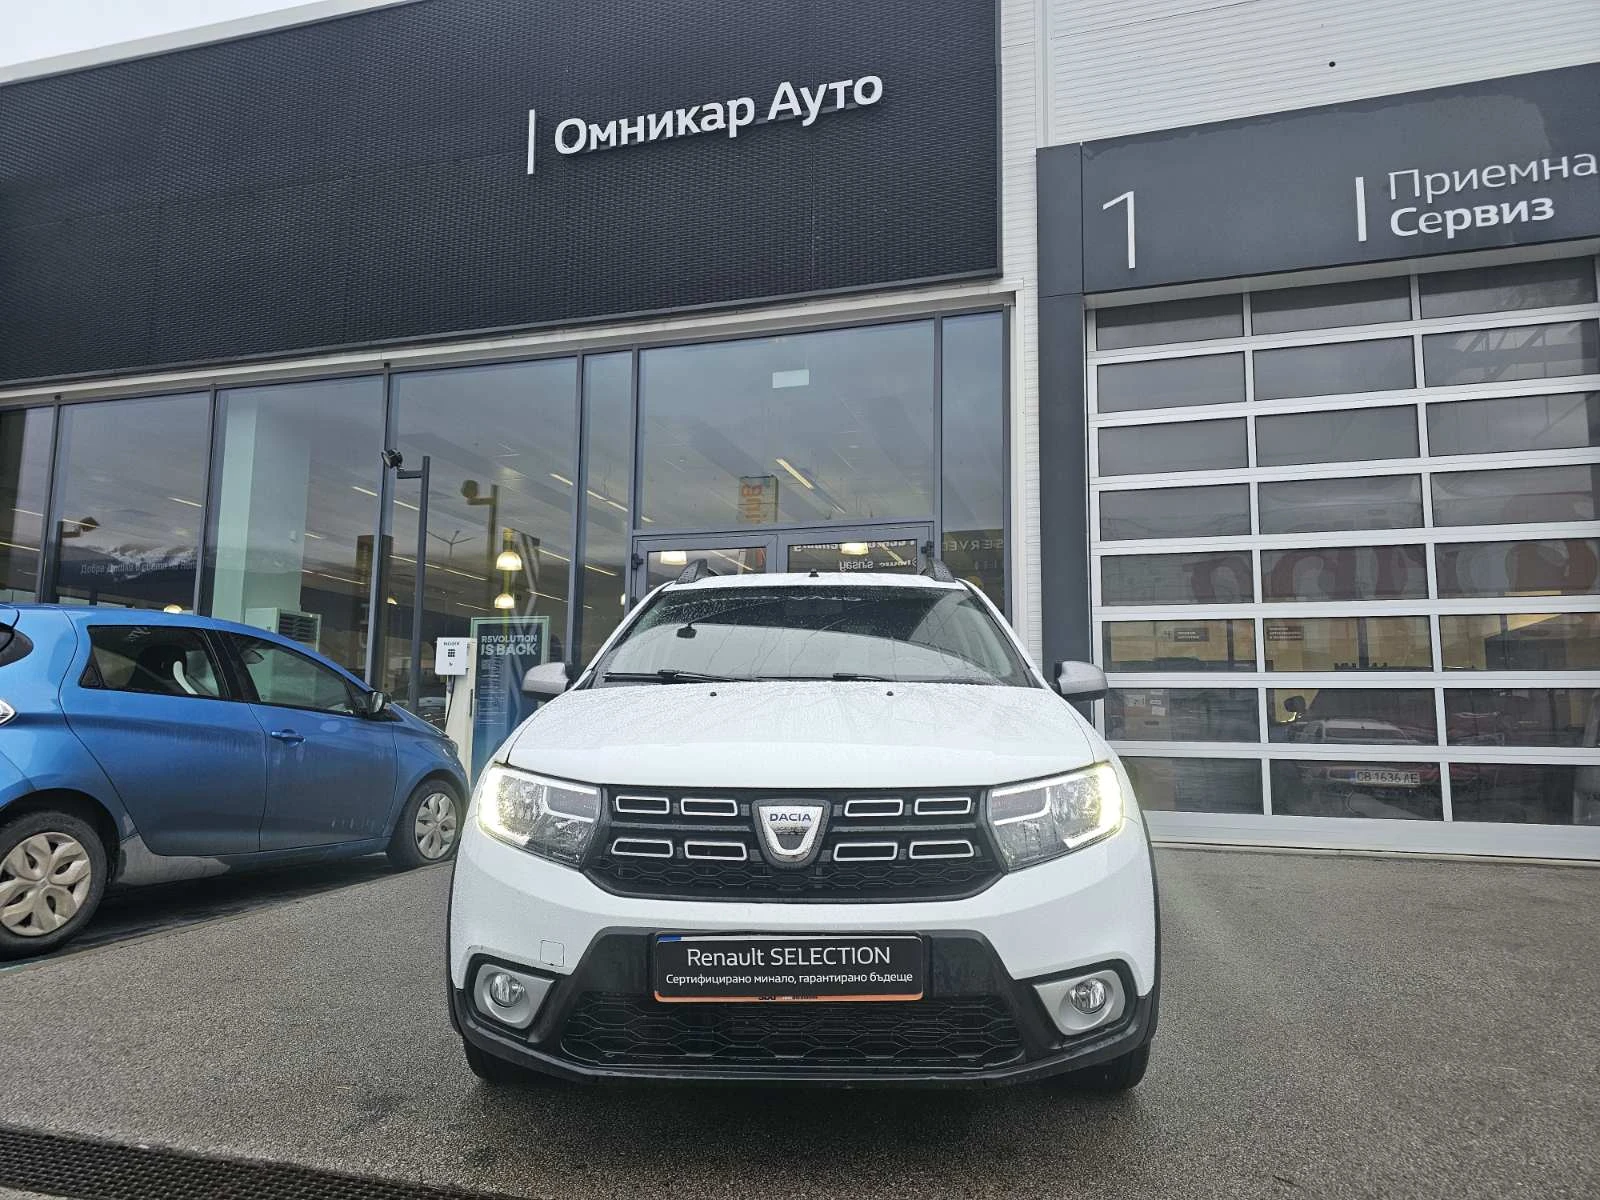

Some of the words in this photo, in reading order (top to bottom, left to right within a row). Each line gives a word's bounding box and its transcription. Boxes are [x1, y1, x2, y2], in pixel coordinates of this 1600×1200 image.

[554, 95, 755, 155] Омникар
[767, 75, 884, 127] Ауто
[1387, 152, 1598, 203] Приемна
[1102, 189, 1136, 269] 1
[1389, 196, 1555, 239] Сервиз
[480, 643, 495, 656] IS
[496, 643, 537, 656] BACK
[769, 813, 811, 822] DACIA
[687, 948, 765, 967] Renault
[770, 946, 891, 966] SELECTION
[665, 973, 752, 986] Сертифицирано
[754, 974, 797, 985] минало,
[799, 973, 868, 984] гарантирано
[869, 971, 913, 983] бъдеще
